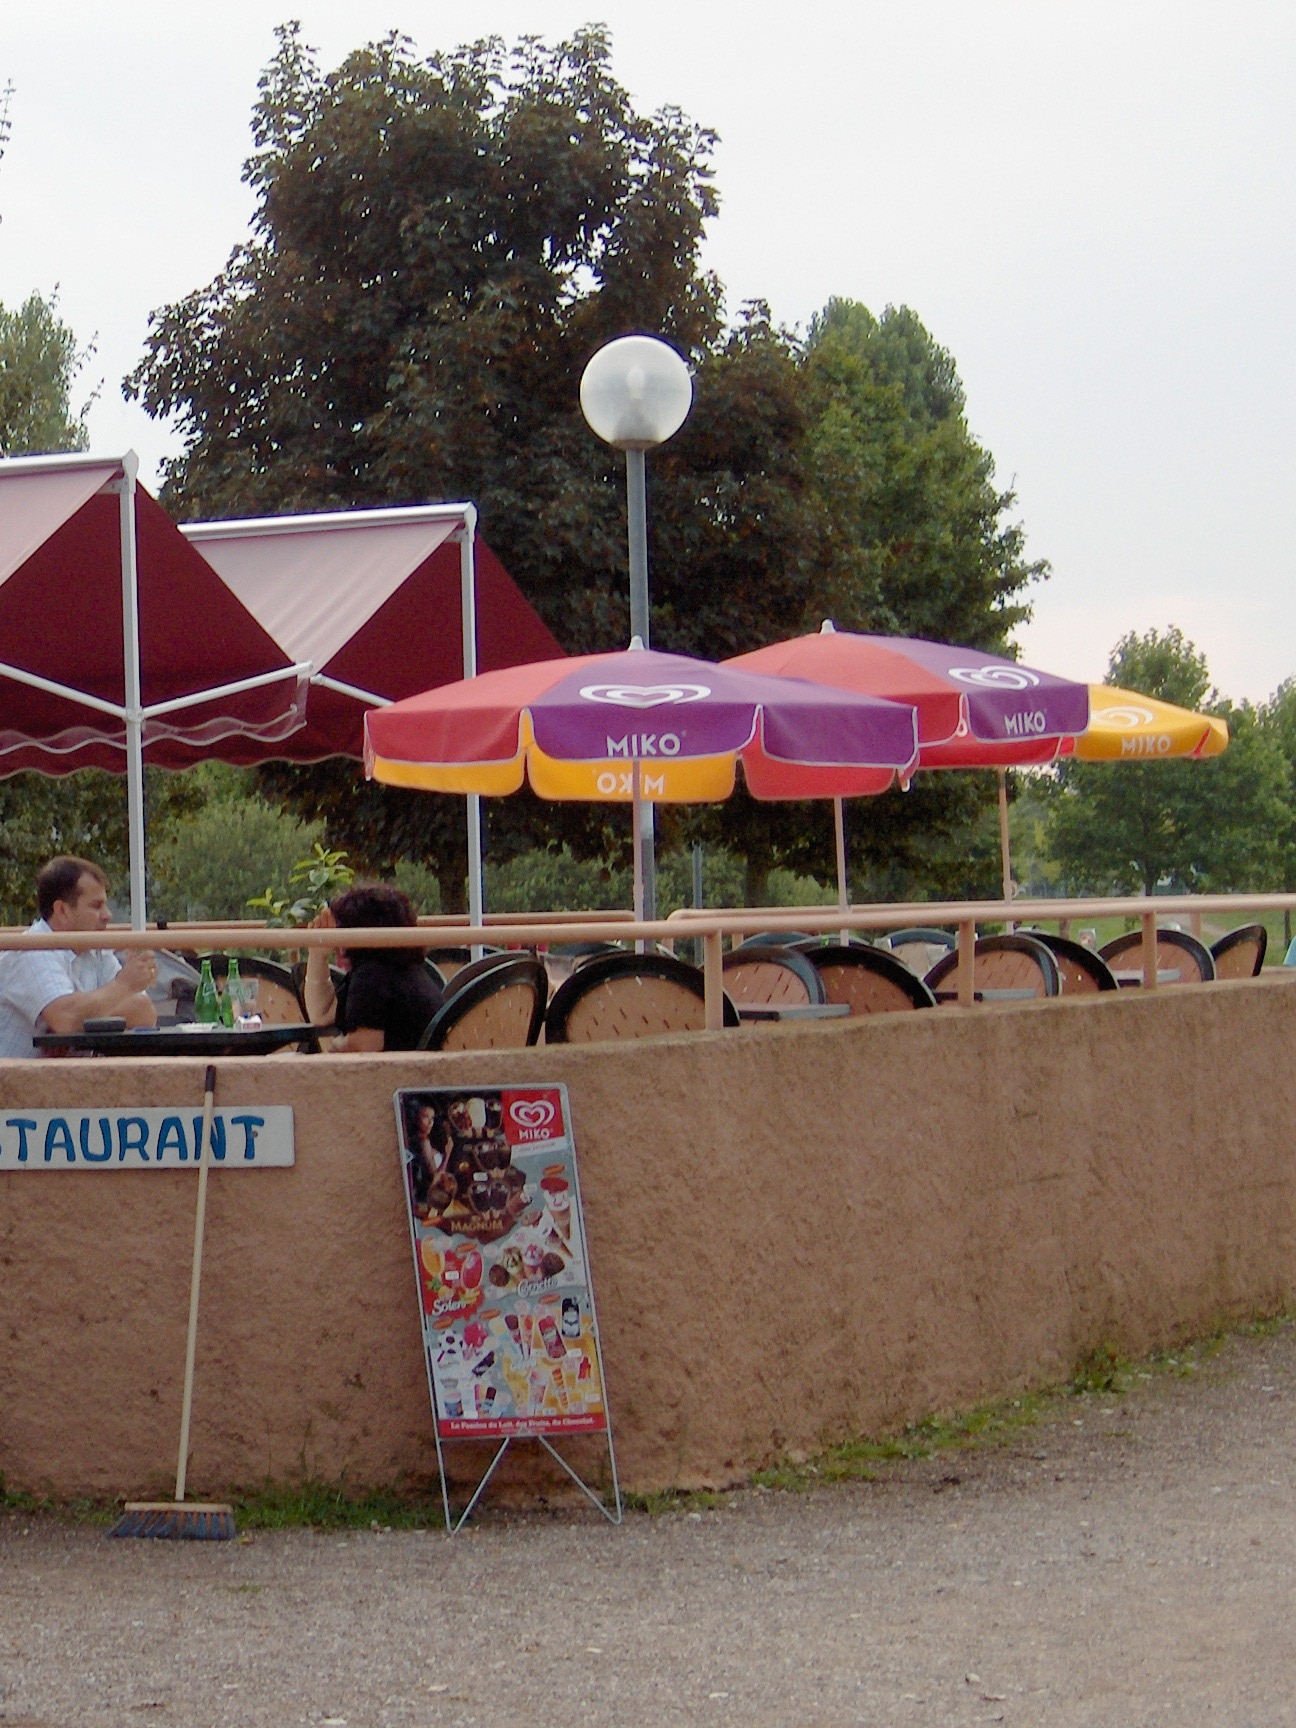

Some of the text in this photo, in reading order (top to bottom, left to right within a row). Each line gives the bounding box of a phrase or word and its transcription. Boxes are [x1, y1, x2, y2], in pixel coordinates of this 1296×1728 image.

[1004, 711, 1046, 735] MIKO
[606, 732, 681, 757] MIKO
[1121, 735, 1171, 755] MIKO
[519, 1127, 550, 1140] MIKO
